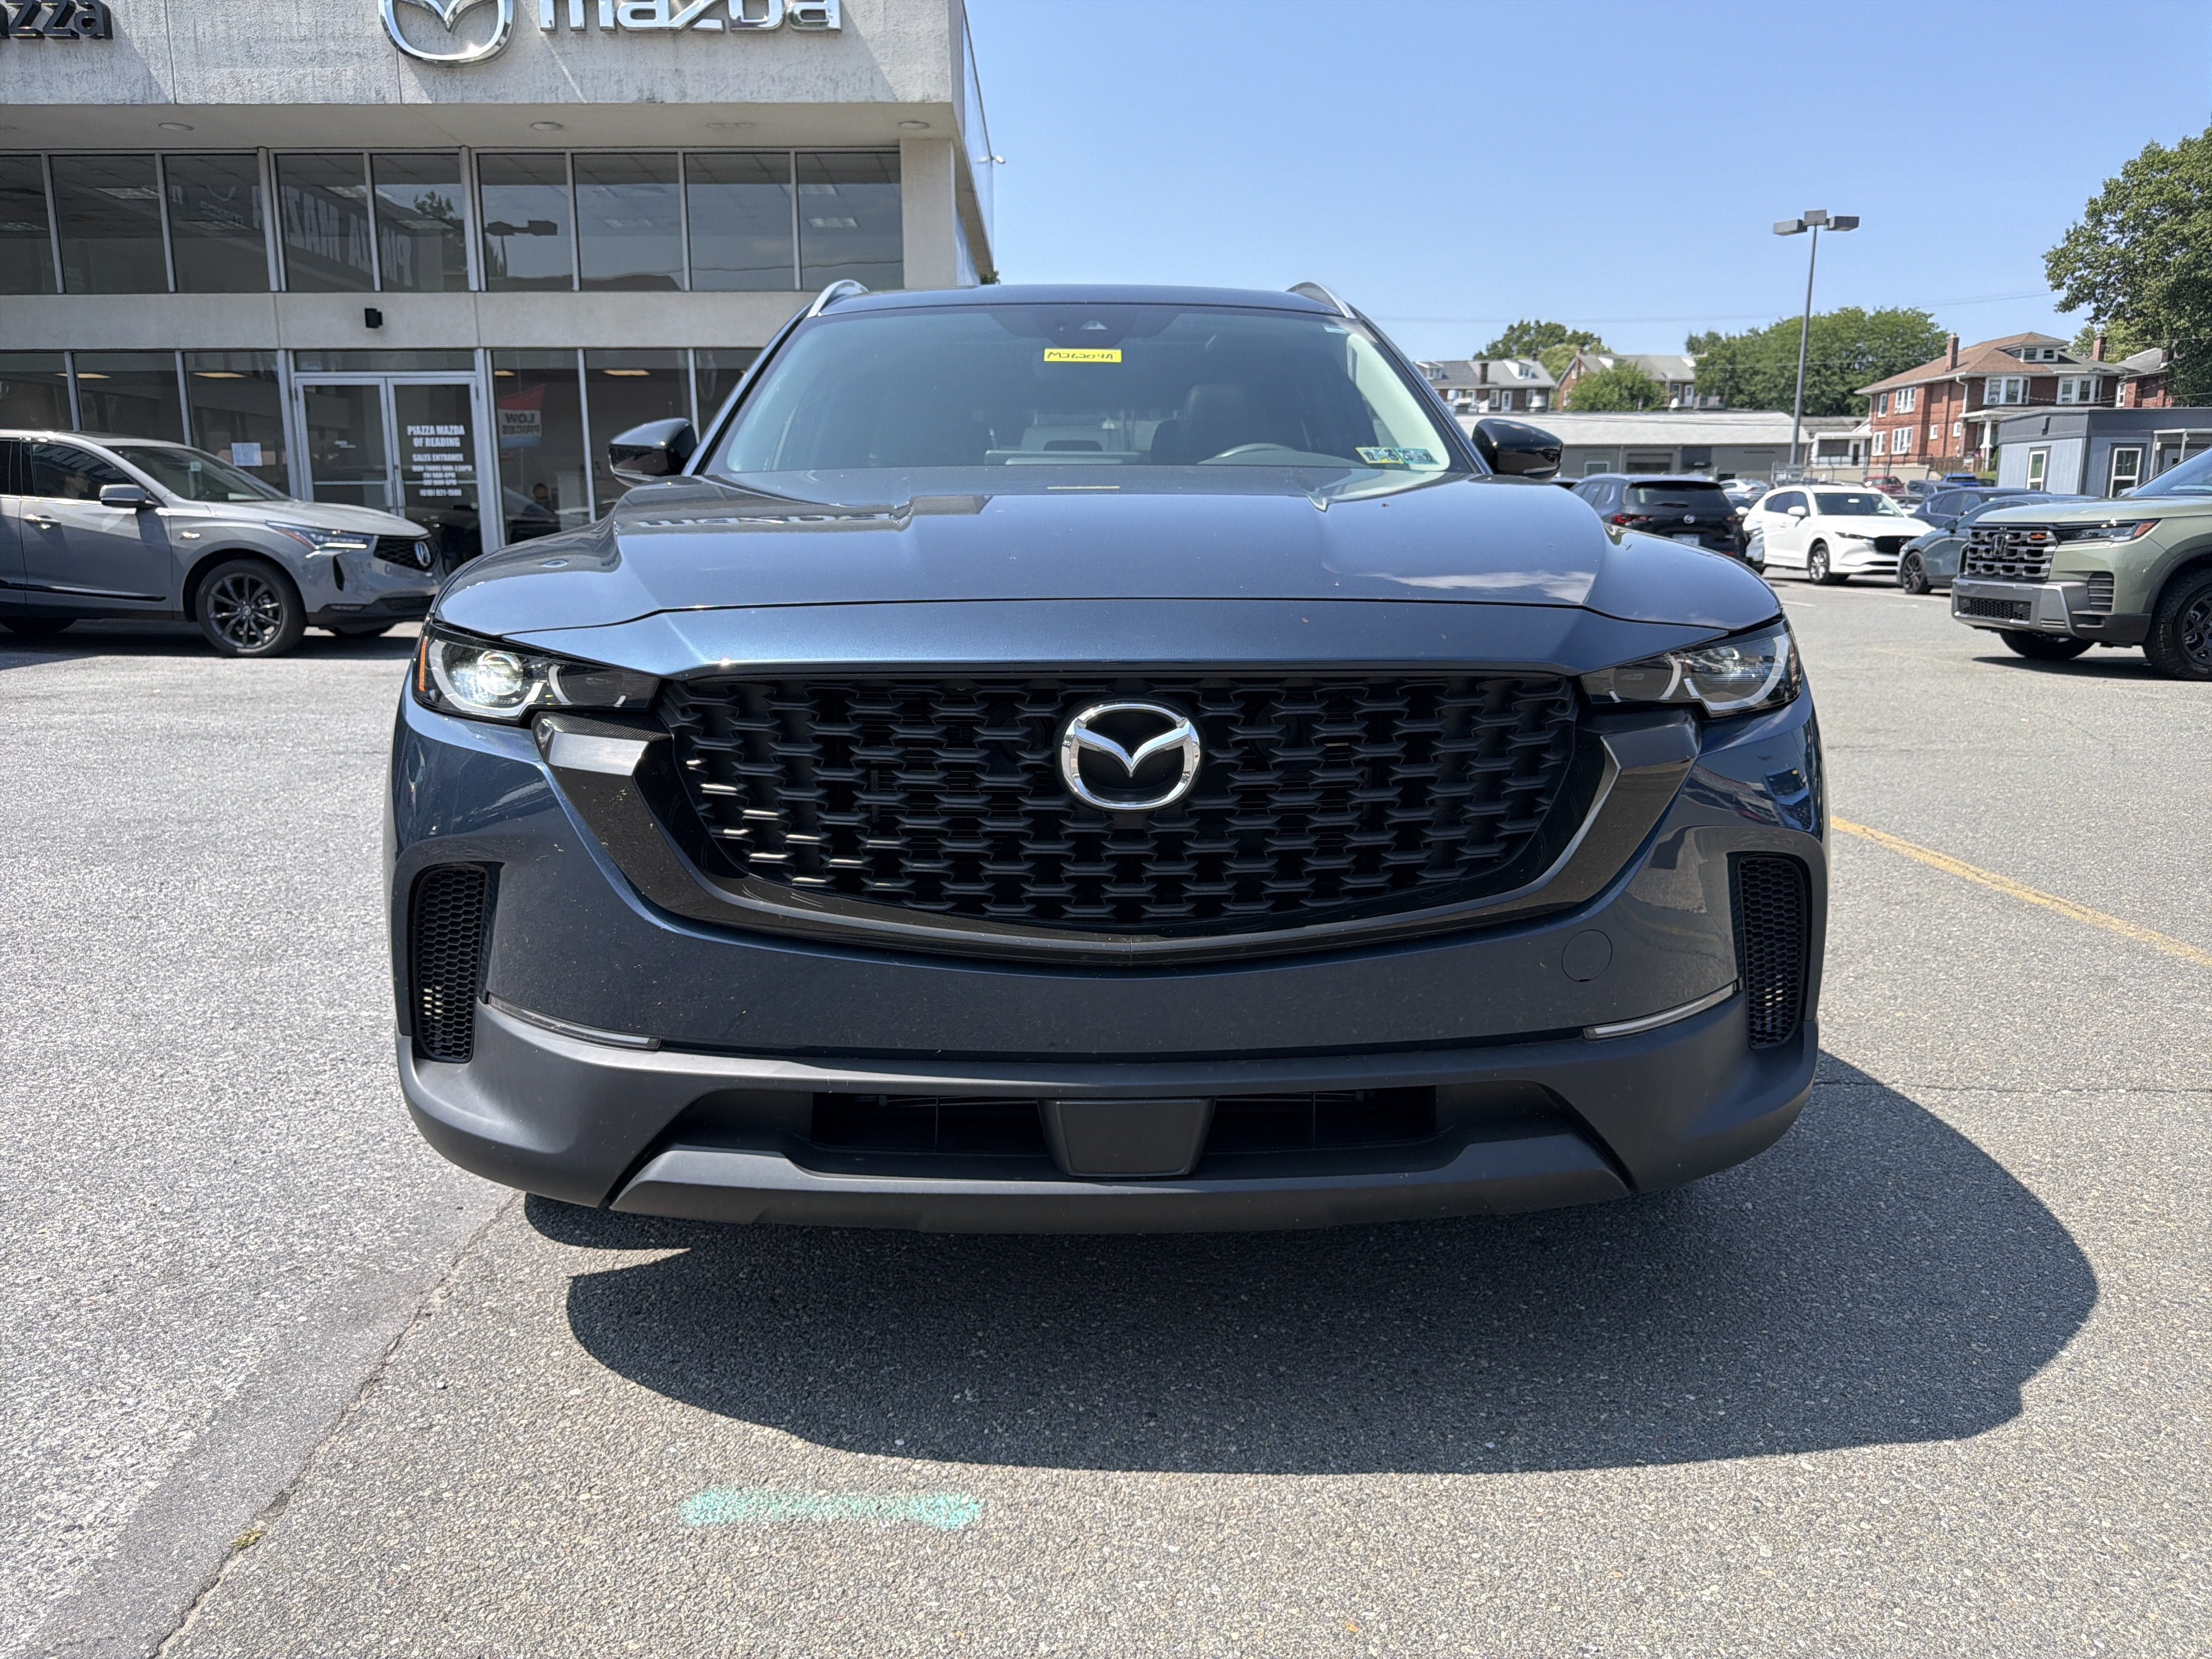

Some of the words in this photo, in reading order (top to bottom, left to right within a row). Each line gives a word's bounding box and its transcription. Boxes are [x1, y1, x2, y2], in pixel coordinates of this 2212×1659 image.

[407, 425, 435, 436] PIAZZA
[436, 425, 465, 435] MAZDA
[413, 437, 423, 447] OF
[425, 437, 461, 447] READING
[432, 453, 464, 461] ENTRANCE
